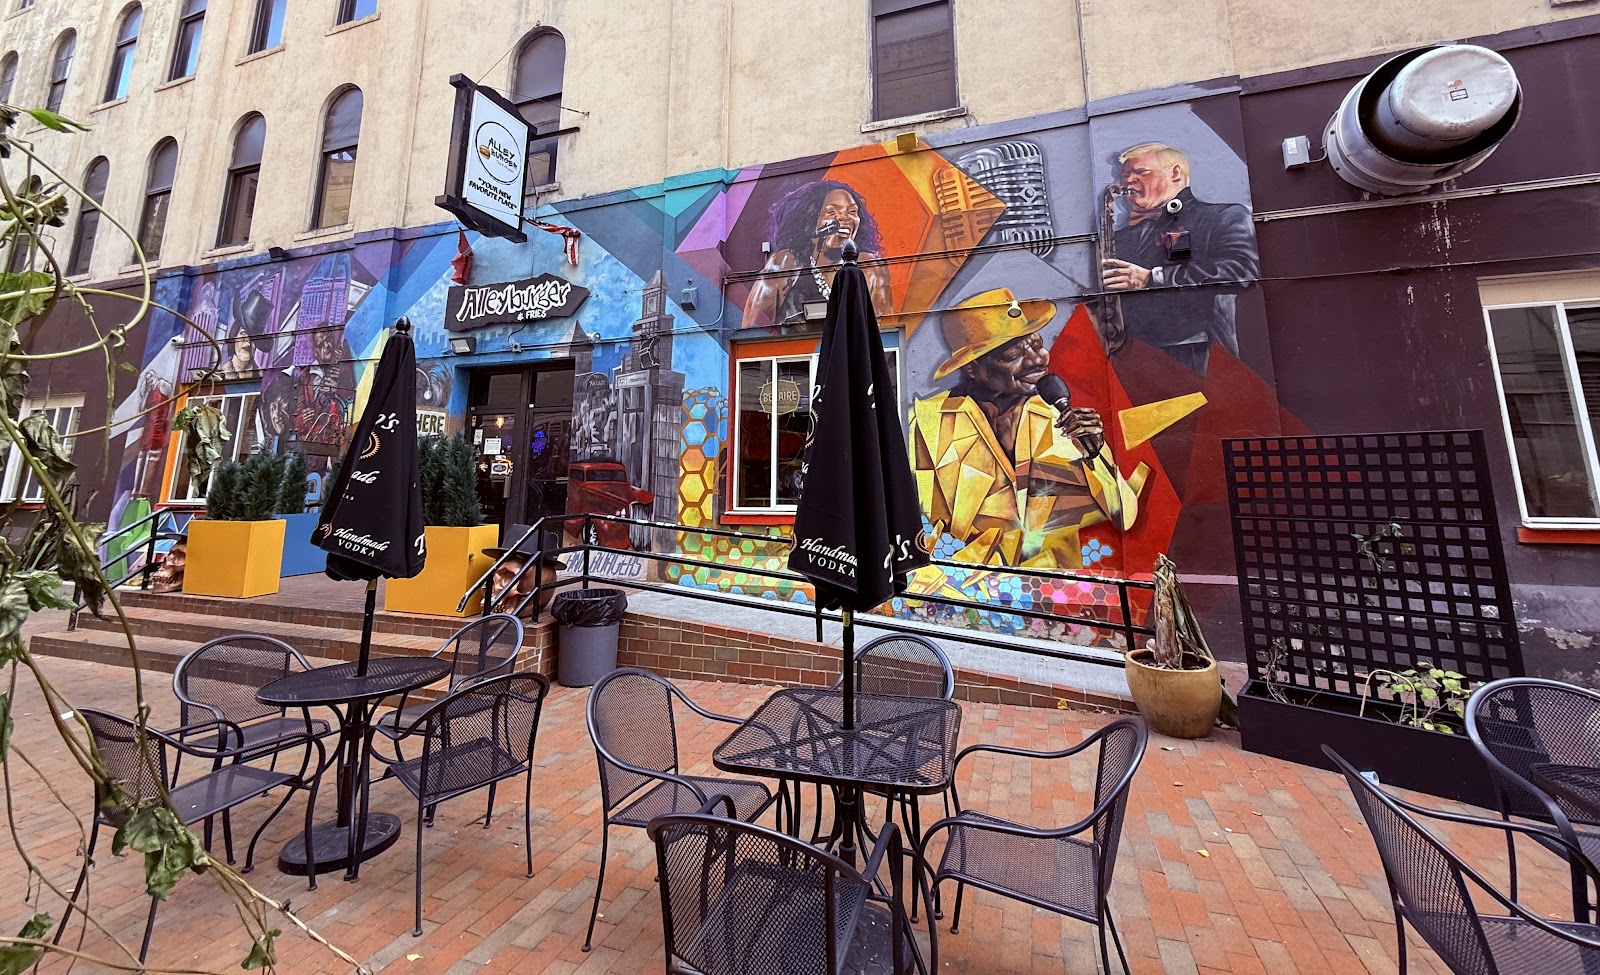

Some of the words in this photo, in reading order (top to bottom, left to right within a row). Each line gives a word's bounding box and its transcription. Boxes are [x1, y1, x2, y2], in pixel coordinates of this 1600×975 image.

[488, 137, 515, 160] ALLEY
[490, 147, 518, 170] BURGER
[468, 180, 498, 201] FAVORITE
[497, 196, 518, 210] PLACE"
[478, 177, 498, 194] "YOUR
[498, 188, 512, 201] NEW
[525, 309, 548, 319] FRIES
[763, 390, 798, 403] BEAIRE
[333, 528, 391, 552] Handmade
[338, 538, 375, 558] VODKA
[799, 537, 858, 567] Handma
[589, 551, 642, 577] BURGERS
[808, 553, 856, 578] VODKA
